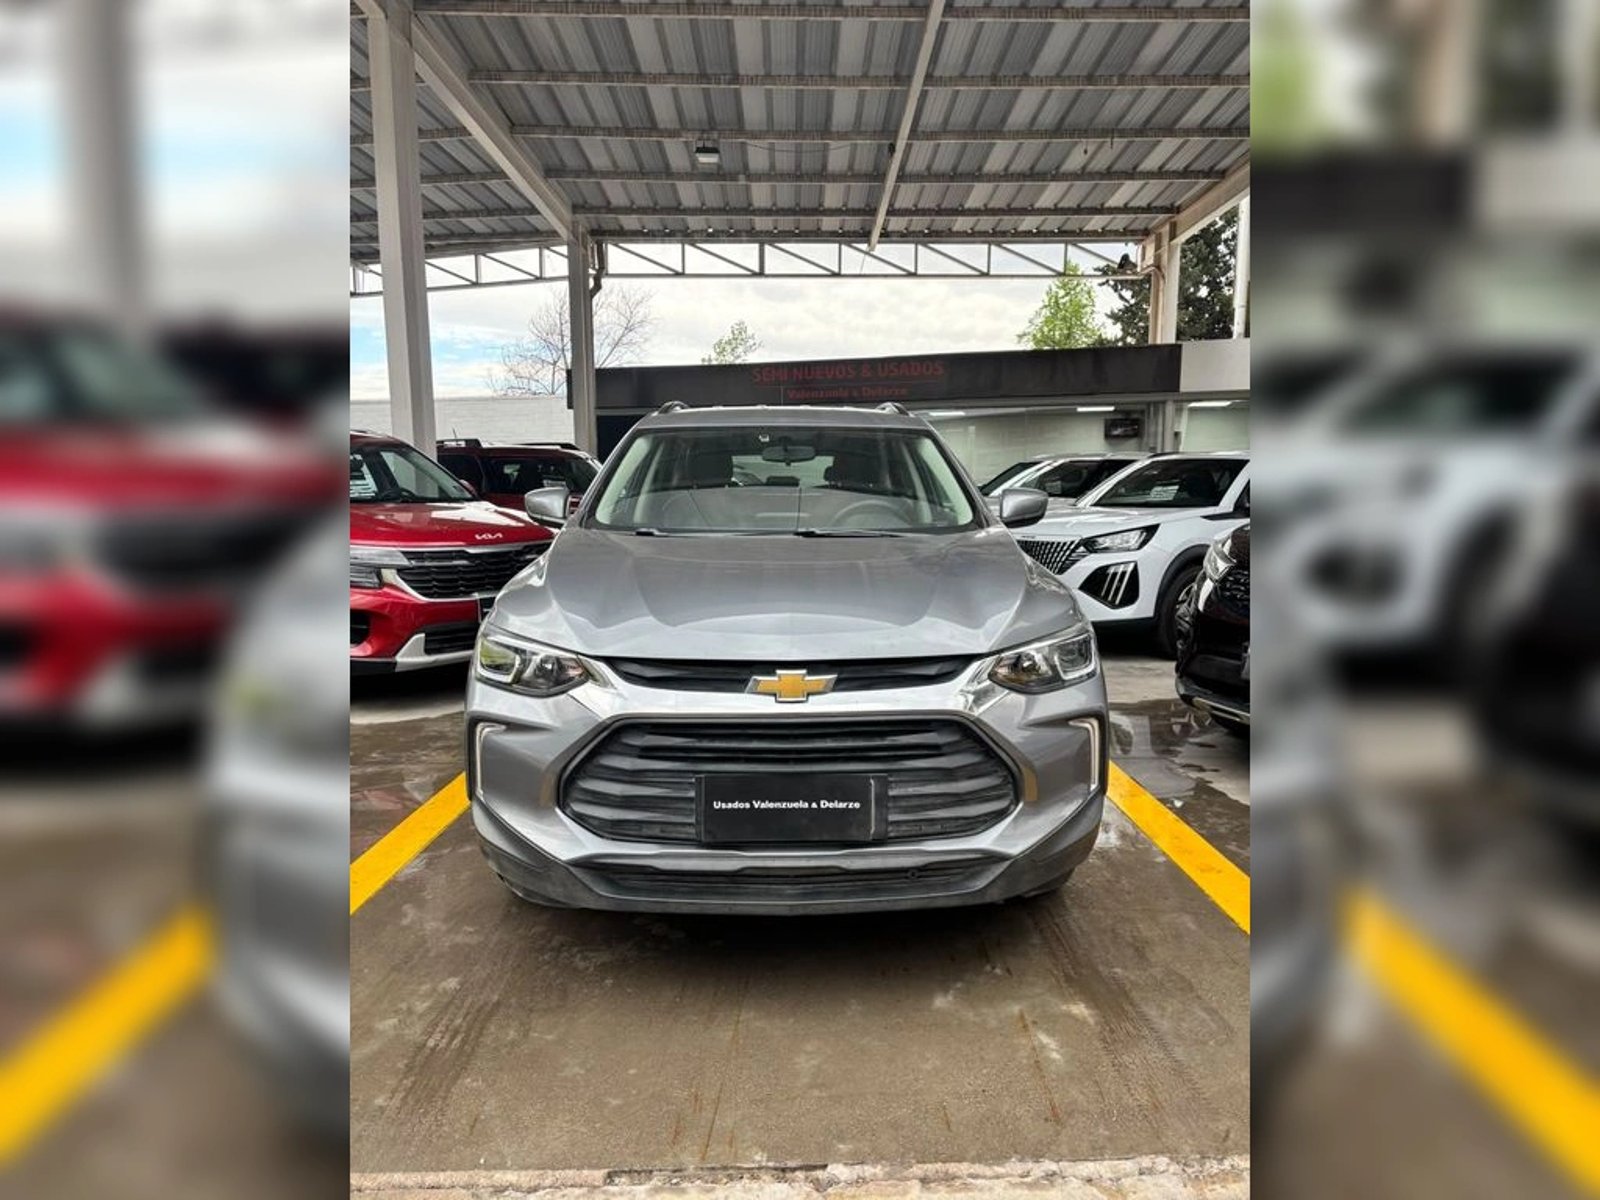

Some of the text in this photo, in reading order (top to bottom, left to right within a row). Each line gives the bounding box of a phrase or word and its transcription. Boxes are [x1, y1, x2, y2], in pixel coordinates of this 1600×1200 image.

[753, 361, 945, 383] SEMI NUEVOS & USADOS
[787, 388, 849, 399] Valenzuela
[713, 799, 861, 809] Usados Valenzuela & Delarze
